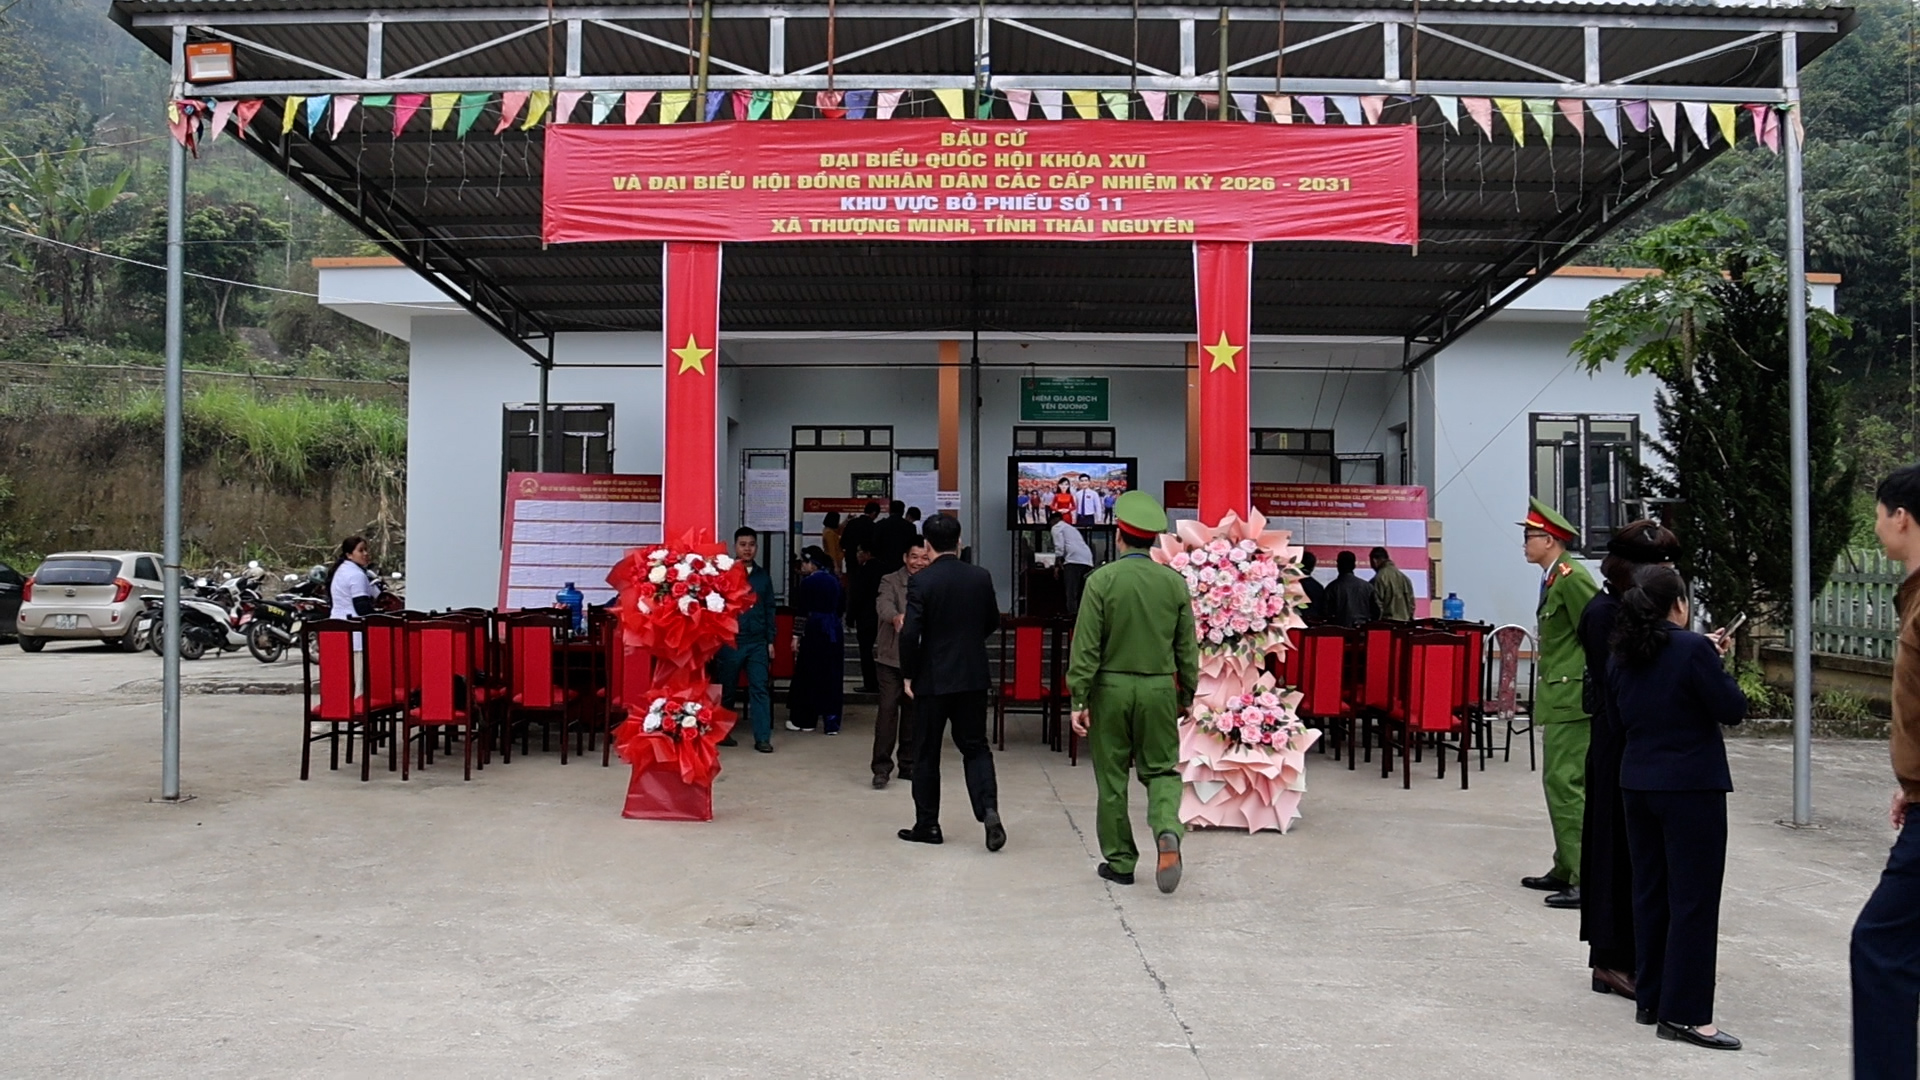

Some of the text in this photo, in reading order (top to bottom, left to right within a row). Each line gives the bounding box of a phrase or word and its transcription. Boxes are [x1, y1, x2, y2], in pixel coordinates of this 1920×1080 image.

[941, 128, 1027, 147] BẦU CỬ
[819, 148, 1145, 171] ĐẠI BIỂU QUỐC HỘI KHÓA XVI
[612, 173, 642, 191] VÀ
[648, 175, 686, 193] ĐẠI
[693, 171, 745, 191] BIỂU
[752, 173, 791, 193] HỘI
[796, 171, 861, 190] ĐỒNG
[867, 172, 933, 190] NHÂN
[940, 171, 988, 190] DÂN
[995, 171, 1041, 190] CÁC
[1048, 170, 1095, 190] CẤP
[1102, 173, 1177, 192] NHIỆM
[1184, 173, 1214, 191] KỲ
[1220, 177, 1276, 191] 2026
[1297, 177, 1350, 192] 2031
[840, 193, 1121, 214] KHU VỰC BỎ PHIẾU SỐ 11
[770, 214, 1195, 236] XÃ THƯỢNG MINH, TỈNH THÁI NGUYÊN
